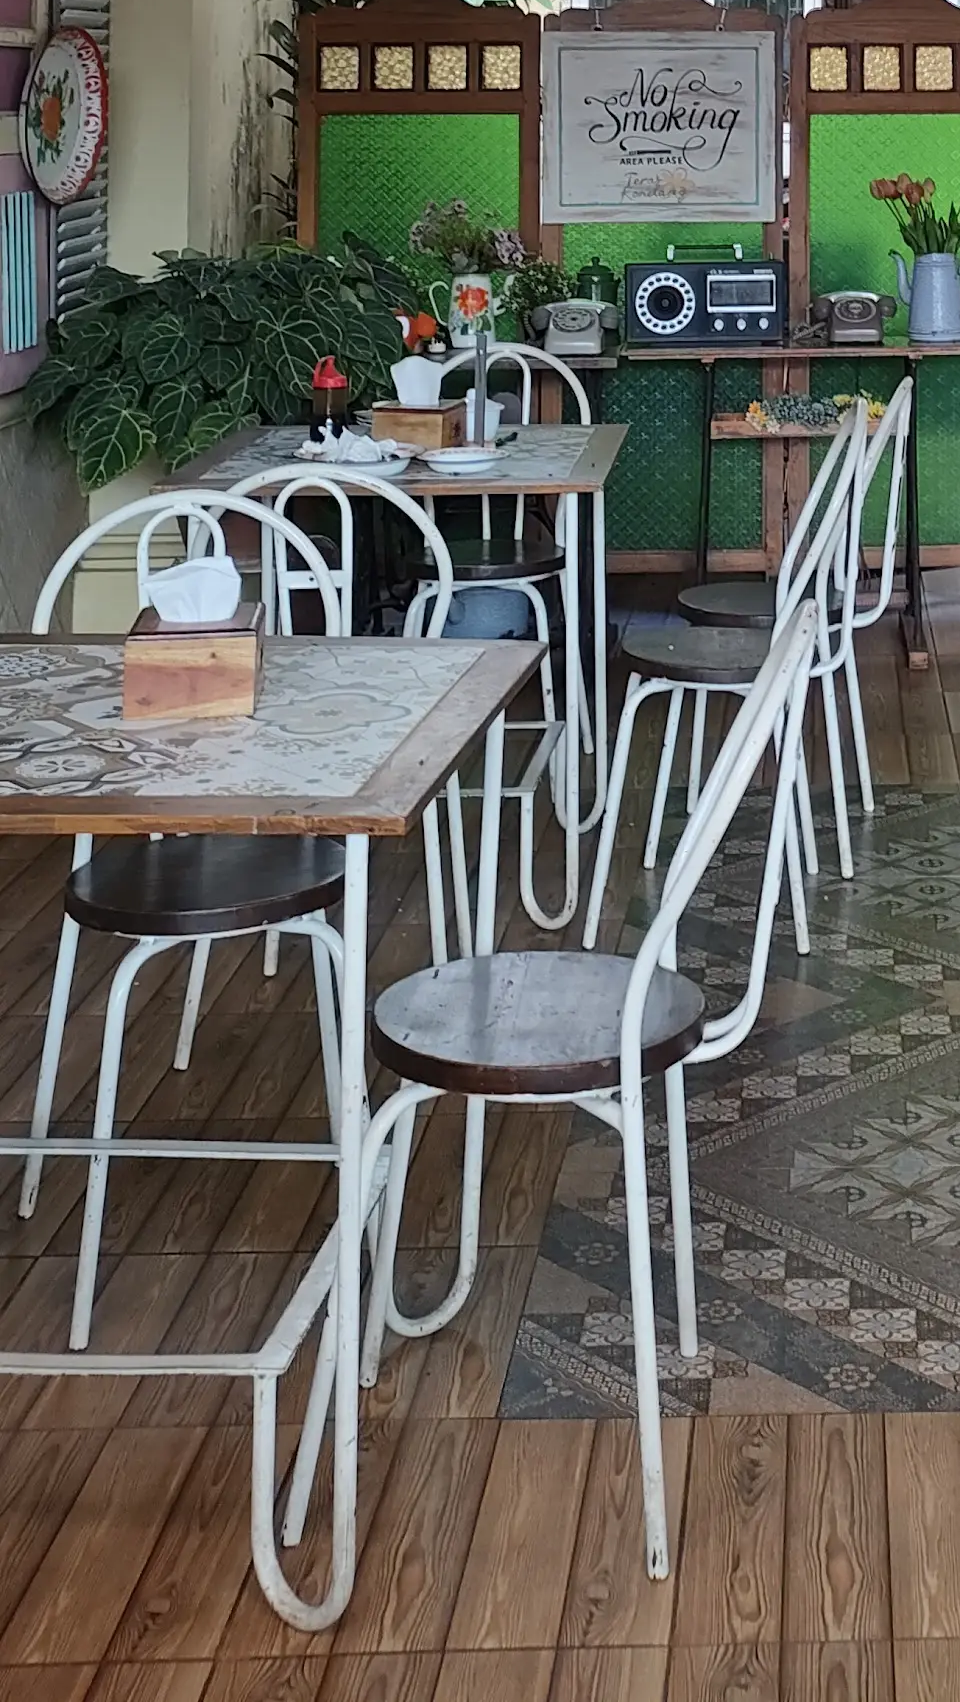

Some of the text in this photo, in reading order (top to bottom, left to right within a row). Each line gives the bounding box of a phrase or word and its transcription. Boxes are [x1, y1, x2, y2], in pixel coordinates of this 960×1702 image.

[619, 67, 673, 108] No
[584, 68, 743, 172] Smoking
[619, 156, 683, 166] AREA PLEASE
